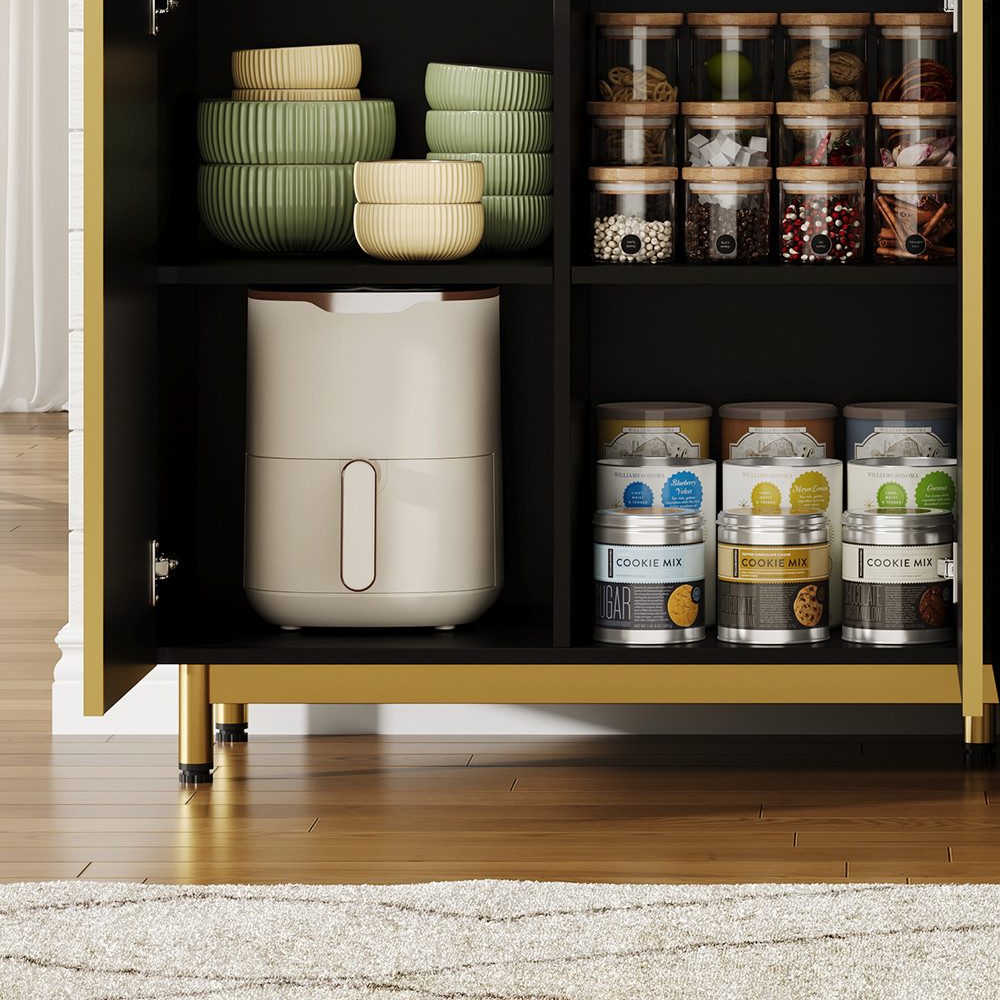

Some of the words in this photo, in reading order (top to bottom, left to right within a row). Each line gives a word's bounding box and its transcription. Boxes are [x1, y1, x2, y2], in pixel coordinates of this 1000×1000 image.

[616, 559, 659, 567] COOKIE
[663, 558, 682, 567] MIX
[742, 558, 785, 567] COOKIE
[788, 558, 808, 567] MIX
[867, 558, 910, 567] COOKIE
[914, 558, 933, 567] MIX
